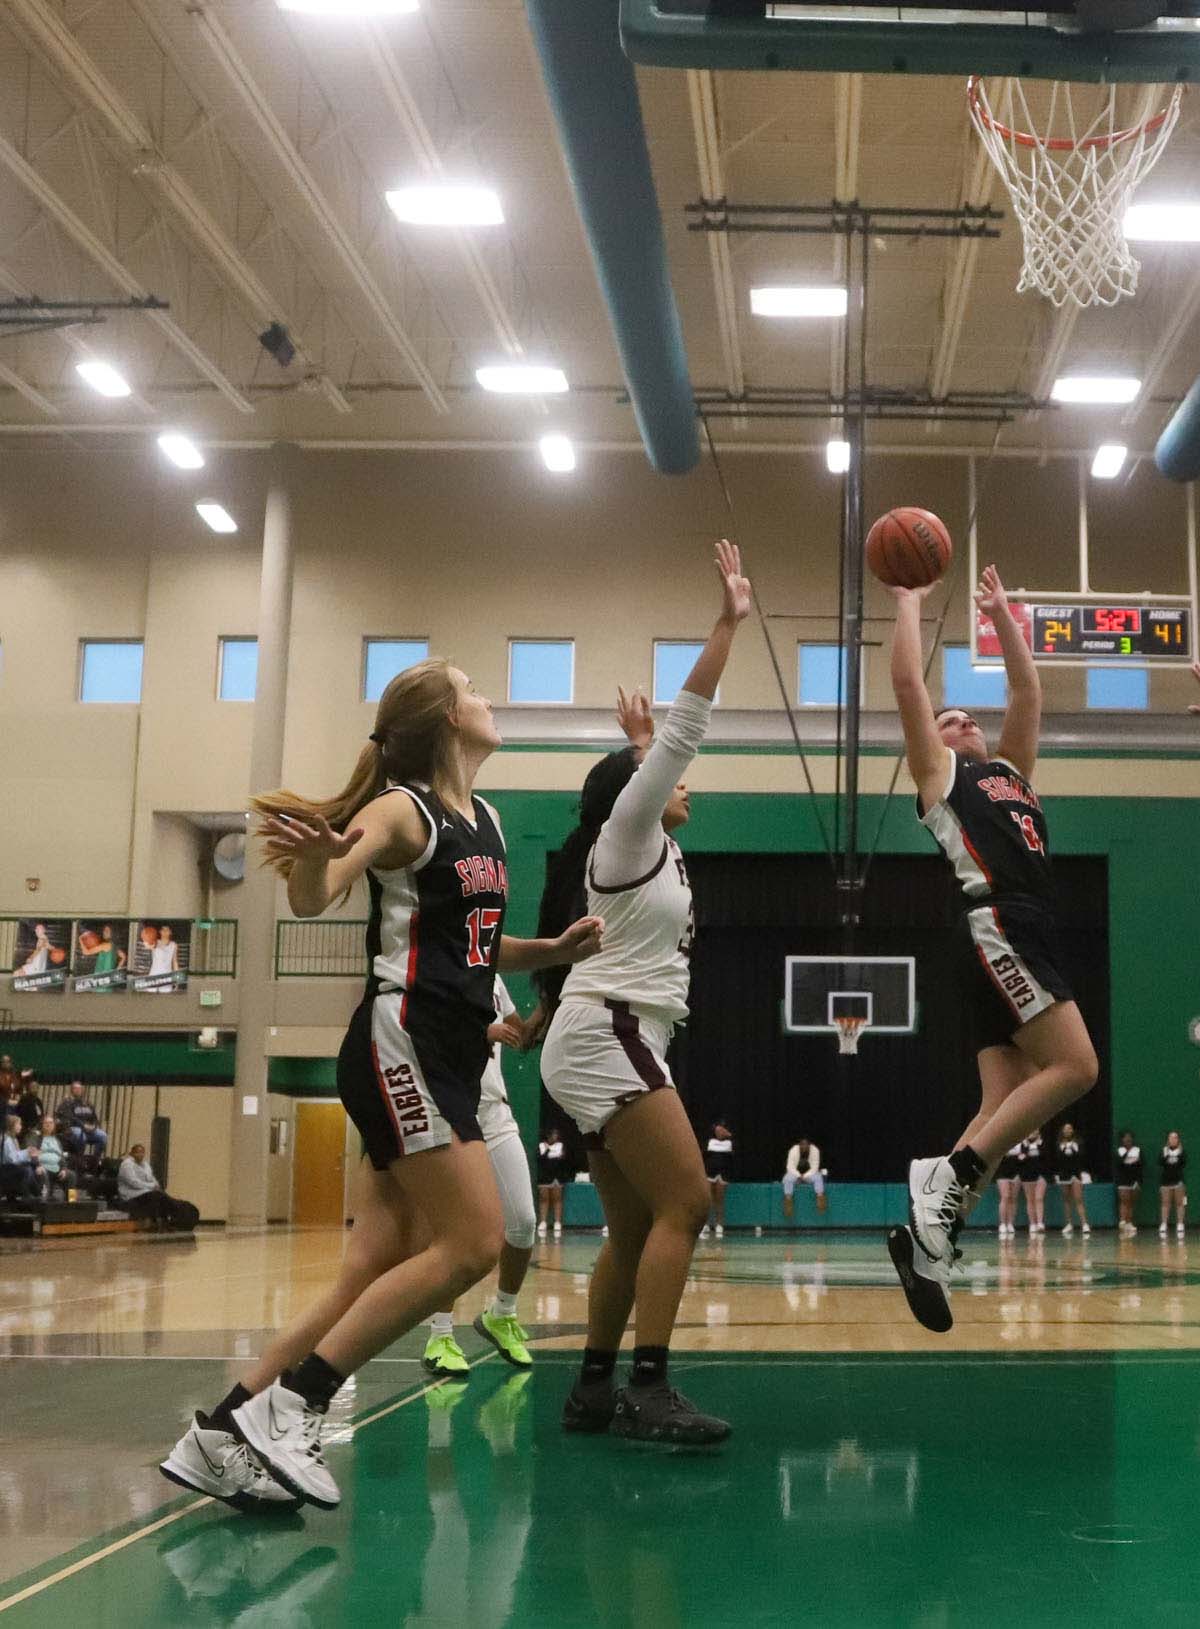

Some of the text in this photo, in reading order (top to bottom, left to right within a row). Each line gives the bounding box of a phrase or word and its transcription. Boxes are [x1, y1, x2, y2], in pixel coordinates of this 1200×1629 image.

[1037, 608, 1074, 618] GUEST
[1149, 610, 1182, 620] HOME
[1044, 620, 1072, 642] 24
[1154, 624, 1182, 644] 41
[1082, 637, 1131, 654] PERIOD 3
[464, 906, 502, 968] 17
[991, 953, 1035, 1010] EAGLES
[384, 1062, 430, 1137] EAGLES
